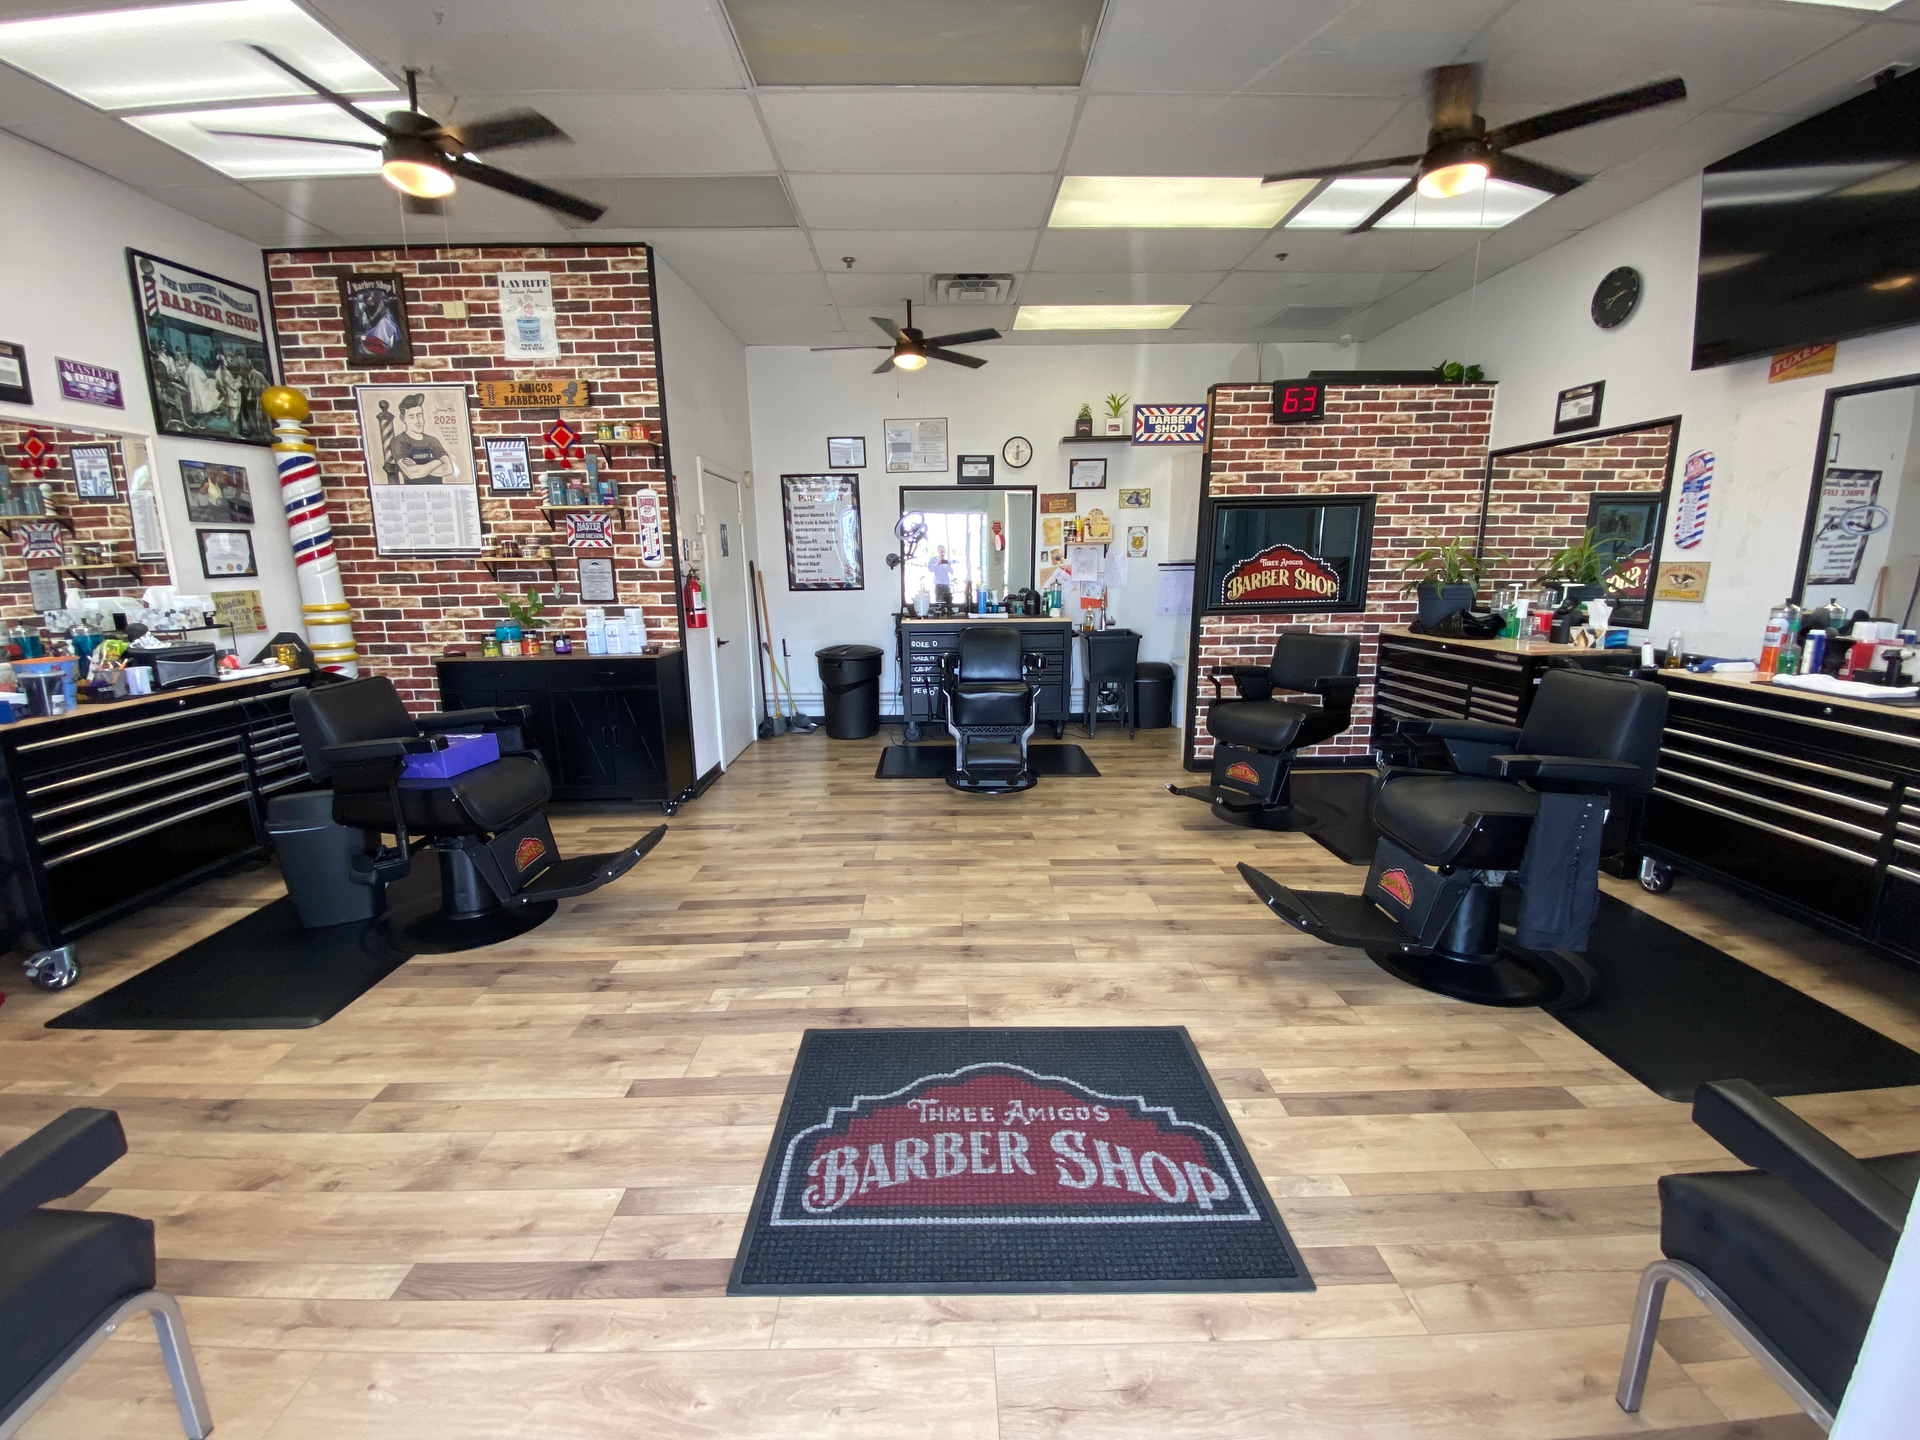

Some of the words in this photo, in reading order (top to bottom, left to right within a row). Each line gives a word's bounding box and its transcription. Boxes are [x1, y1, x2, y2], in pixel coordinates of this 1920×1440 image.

[160, 273, 178, 292] THE
[178, 282, 217, 296] VANISHING
[351, 281, 375, 292] Barber
[375, 280, 392, 293] Shop
[501, 279, 549, 288] LAYRITE
[159, 290, 224, 324] BARBER
[225, 310, 259, 333] SHOP
[64, 361, 115, 381] MASTER
[77, 374, 105, 386] LILAC
[510, 383, 516, 393] 3
[518, 382, 554, 394] AMIGOS
[504, 394, 562, 406] BARBERSHOP
[1282, 386, 1318, 413] 63
[434, 415, 457, 425] 2026
[1148, 415, 1193, 424] BARBER
[1154, 424, 1186, 433] SHOP
[577, 522, 603, 532] MASTER
[1660, 565, 1684, 579] EAGLE
[1227, 569, 1290, 600] BARBER
[1294, 568, 1337, 597] SHOP
[214, 597, 247, 614] Klondike
[229, 607, 251, 616] HEAD
[233, 614, 251, 622] RUB
[801, 1131, 1037, 1214] BARBER
[1049, 1129, 1230, 1211] SHOP
